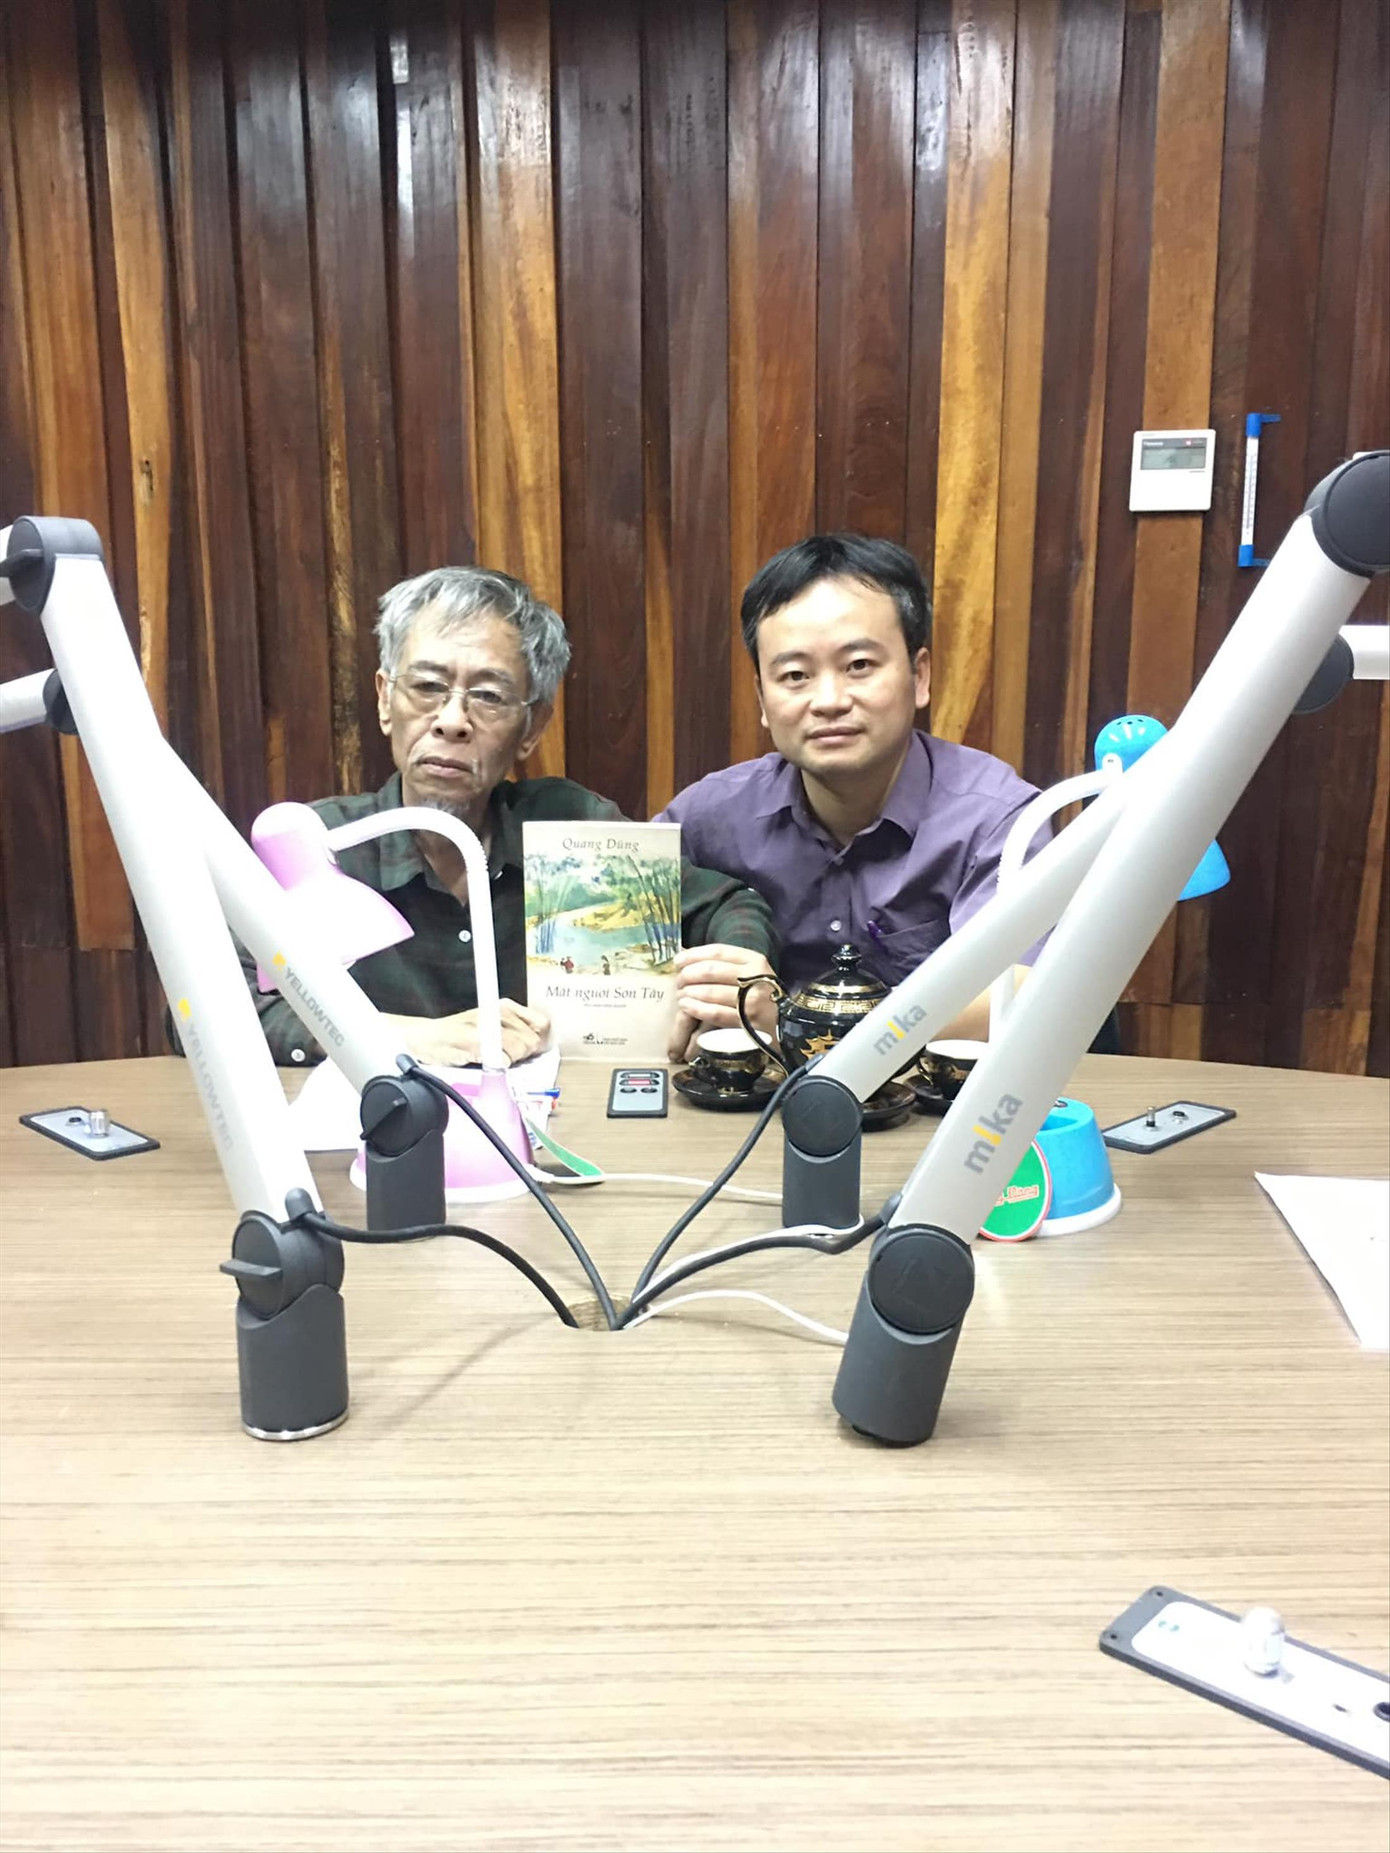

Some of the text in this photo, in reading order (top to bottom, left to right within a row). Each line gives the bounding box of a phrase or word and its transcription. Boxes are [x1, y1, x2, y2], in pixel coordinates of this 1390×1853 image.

[562, 837, 602, 852] Quang
[286, 967, 344, 1047] YELLOWTEC
[964, 1093, 1023, 1174] mika
